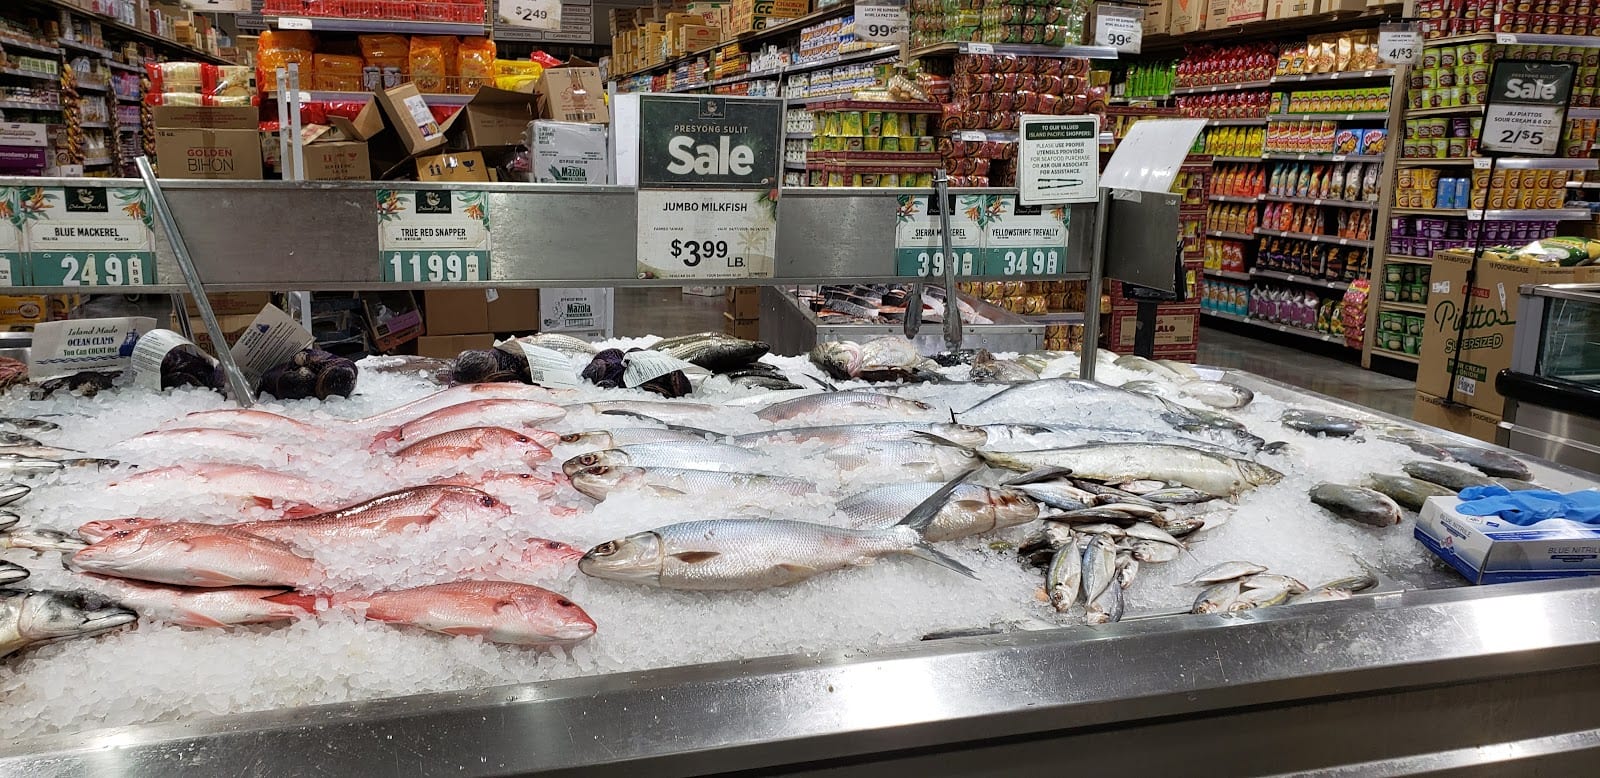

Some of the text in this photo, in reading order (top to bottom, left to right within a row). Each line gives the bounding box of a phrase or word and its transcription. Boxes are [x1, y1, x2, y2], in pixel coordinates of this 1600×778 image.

[868, 24, 899, 37] 99¢
[1107, 33, 1132, 46] 99¢
[1389, 48, 1412, 59] 4/$3
[1504, 78, 1557, 100] Sale
[674, 124, 749, 134] PRESYONG SULIT
[1500, 130, 1544, 145] 2/$5
[187, 149, 232, 157] GOLDEN
[667, 135, 755, 175] Sale
[187, 158, 234, 172] BIHON
[561, 166, 586, 177] Mazola
[663, 202, 747, 212] JUMBO MILKFISH
[55, 227, 119, 237] BLUE MACKEREL
[401, 228, 466, 237] TRUE RED SNAPPER
[915, 228, 966, 237] SIERRA MEREL
[992, 228, 1059, 237] YELLOWSTRIPE TREVALLY
[727, 257, 746, 268] LB.
[567, 303, 591, 313] Mazola
[68, 325, 118, 336] Island Made
[67, 336, 114, 347] OCEAN CLAMS
[1445, 332, 1503, 354] SUERSIZED
[76, 348, 87, 356] Can
[88, 347, 106, 355] COUNT
[1440, 513, 1472, 538] BLUE NITRILE
[1571, 546, 1600, 554] NITRIL
